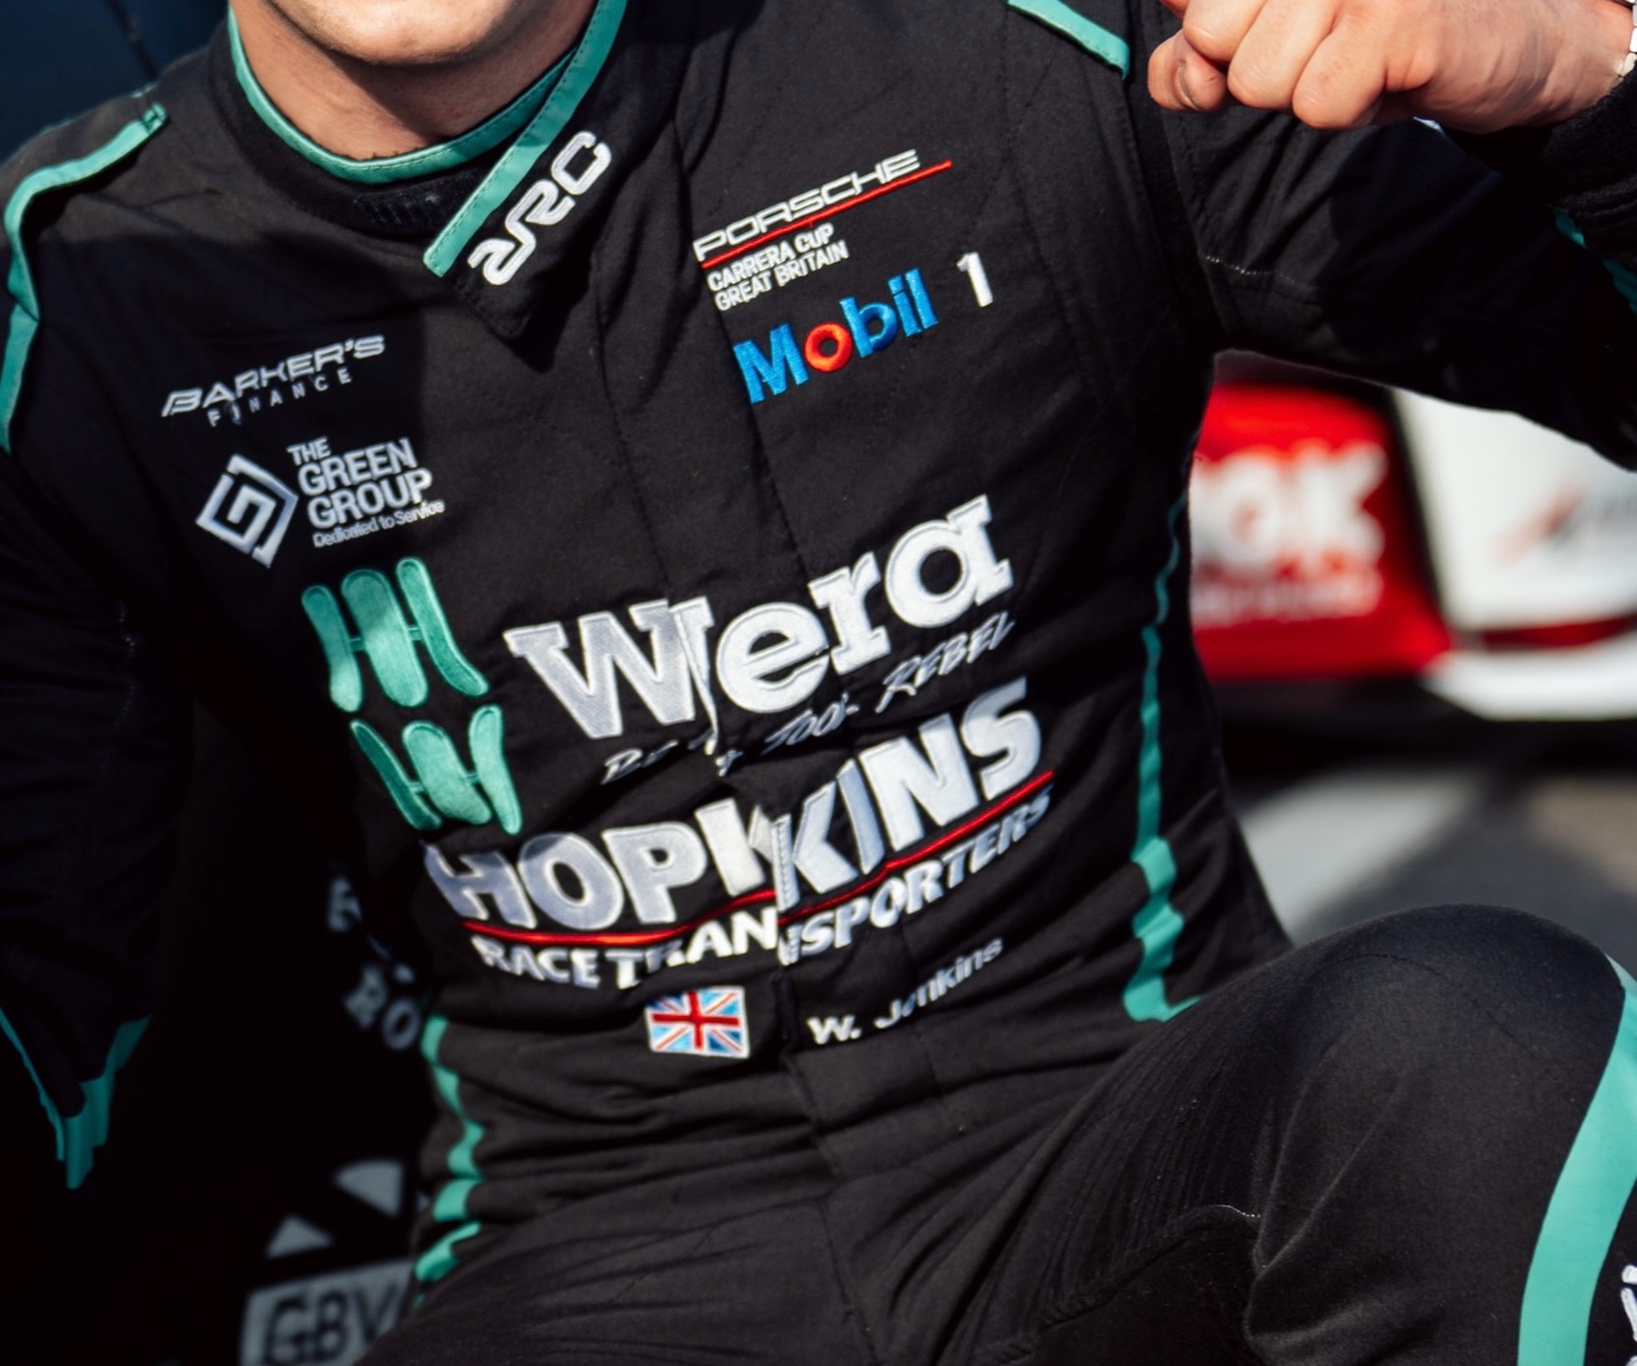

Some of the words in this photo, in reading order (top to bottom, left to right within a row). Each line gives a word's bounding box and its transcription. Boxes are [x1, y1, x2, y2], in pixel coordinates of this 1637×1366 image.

[692, 149, 921, 262] PORSCHE
[706, 240, 797, 292] CARRERA
[794, 222, 835, 254] CUP
[714, 273, 773, 312] GREAT
[775, 239, 850, 287] BRITAIN
[733, 268, 939, 404] Mobil
[957, 251, 993, 308] 1
[161, 335, 385, 417] BARKER'S
[207, 367, 352, 427] FINANCE
[286, 436, 331, 466] THE
[297, 438, 418, 496] GREEN
[306, 468, 432, 529] GROUP
[312, 517, 379, 548] Dedicated
[378, 515, 395, 531] to
[394, 499, 445, 525] Service
[503, 493, 1014, 751] Wera
[875, 611, 1017, 714] REBEL
[419, 676, 1044, 930] HOPKINS
[470, 935, 601, 991] RACE
[807, 1013, 863, 1046] W.
